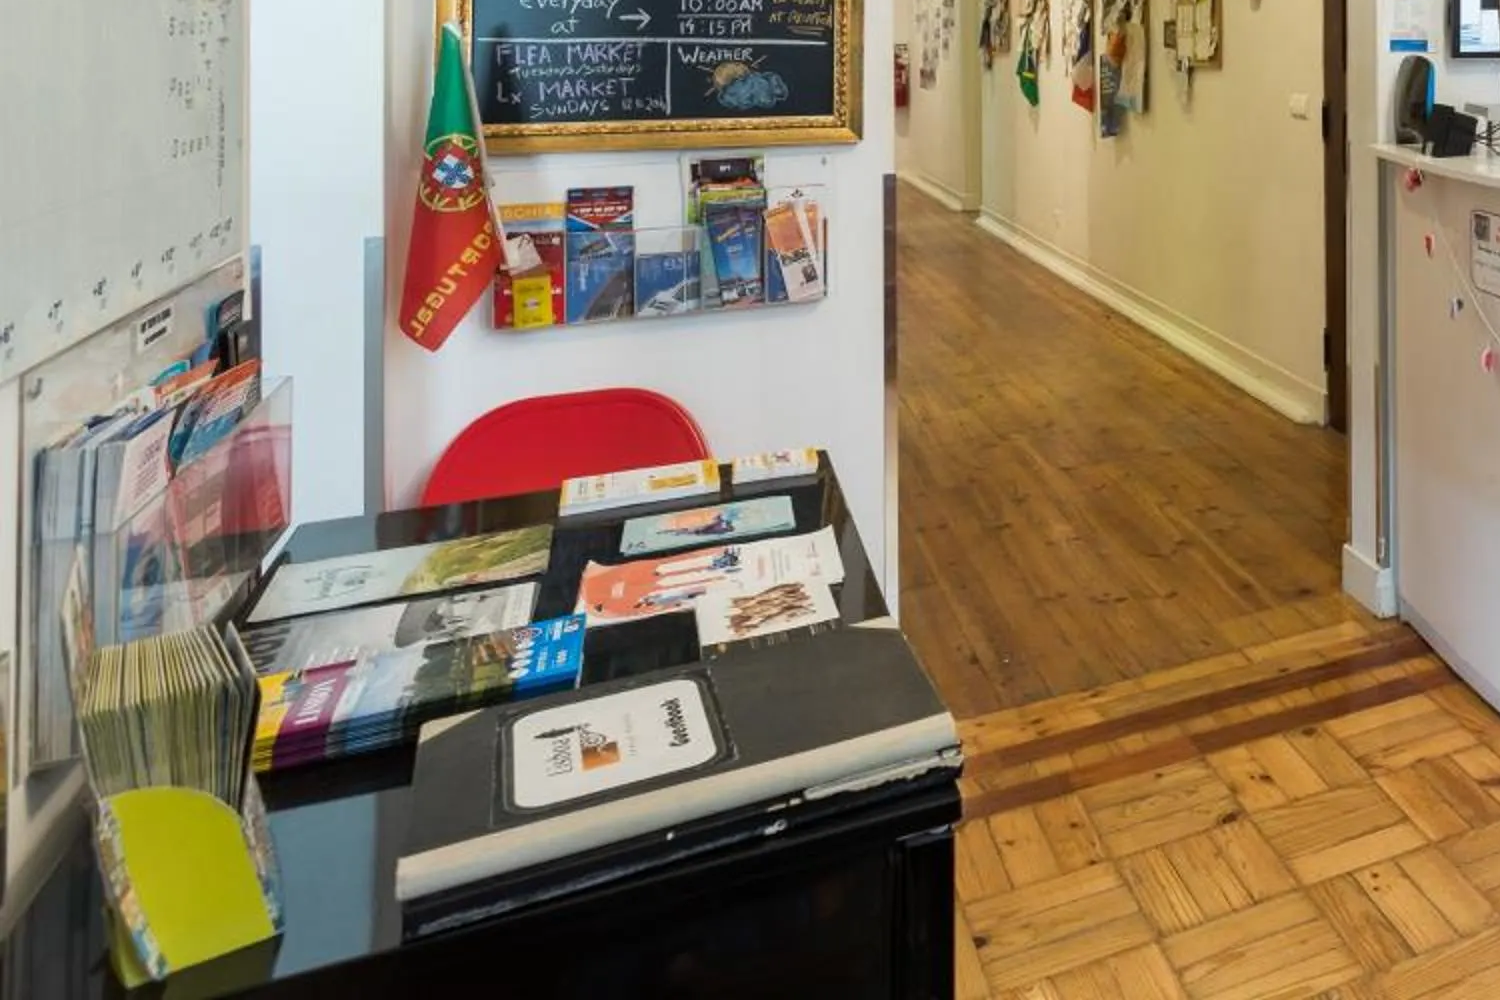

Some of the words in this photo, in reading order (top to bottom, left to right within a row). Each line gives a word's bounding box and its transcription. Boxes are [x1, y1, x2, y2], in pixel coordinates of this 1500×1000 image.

[550, 17, 581, 35] at
[496, 43, 552, 67] FLEA
[566, 41, 648, 65] MARKET
[677, 45, 754, 64] WEATHER
[538, 76, 636, 101] MARKET
